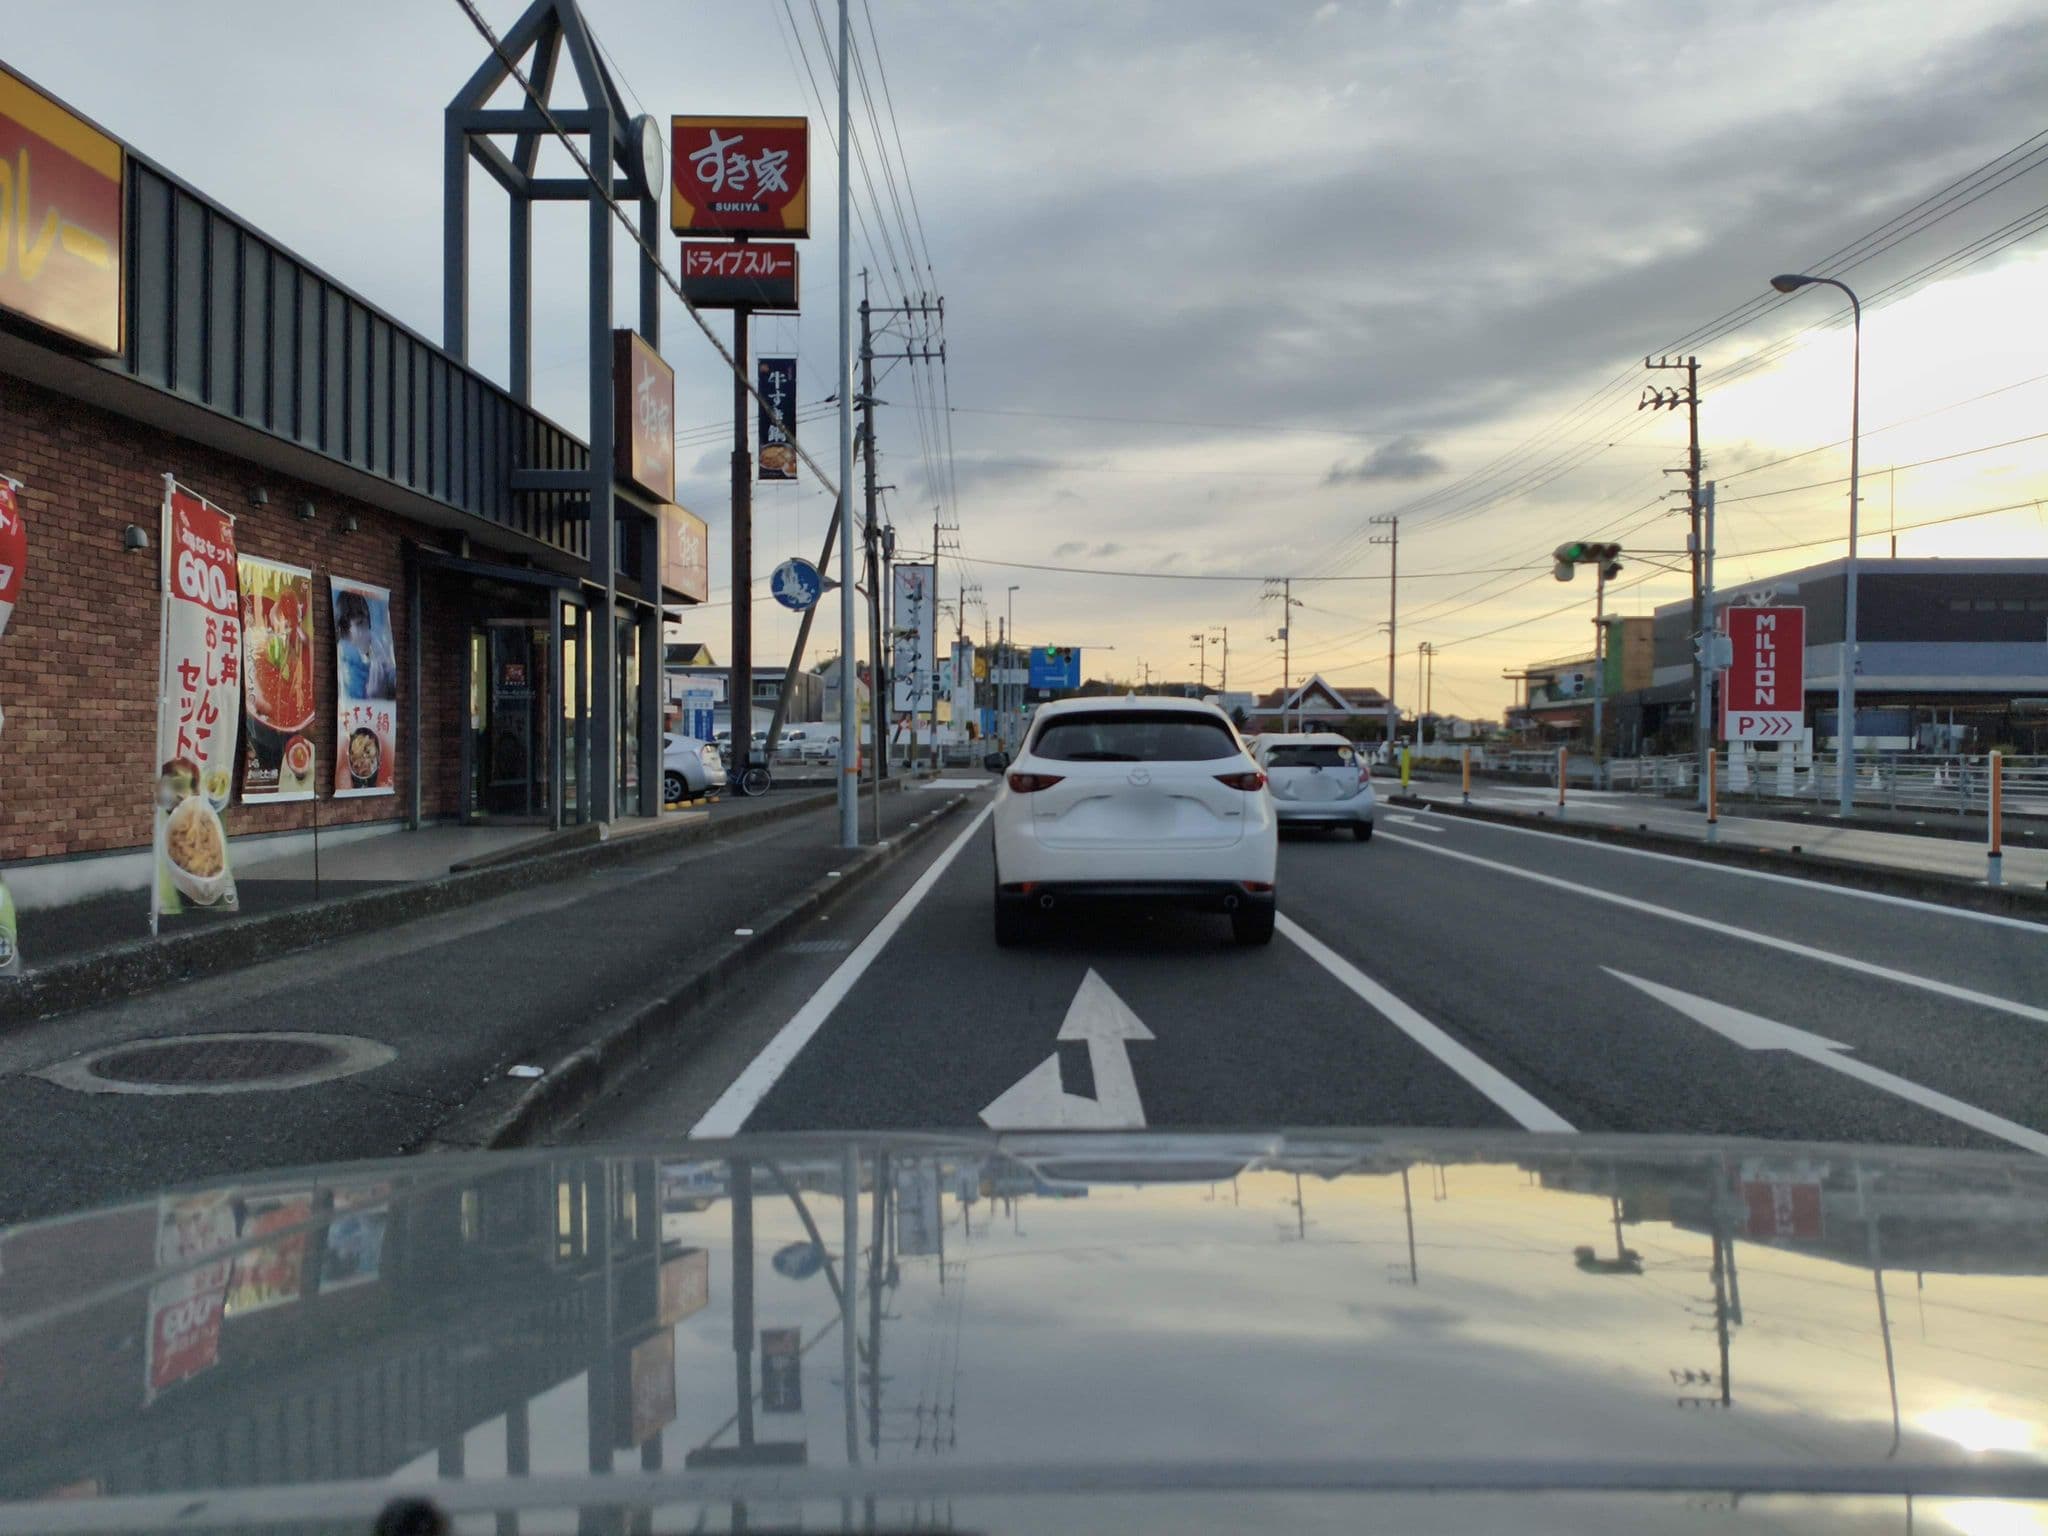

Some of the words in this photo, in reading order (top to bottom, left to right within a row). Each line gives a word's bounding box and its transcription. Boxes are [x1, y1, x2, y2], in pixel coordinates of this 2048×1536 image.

[689, 128, 789, 200] すき家
[715, 202, 760, 211] SUKIYA
[686, 249, 792, 275] ドライブスルー
[178, 550, 238, 611] 600円
[221, 620, 238, 687] 牛丼
[1755, 614, 1776, 705] MILLION
[176, 658, 201, 759] セット
[195, 616, 219, 761] おしんこ
[1738, 716, 1755, 735] P
